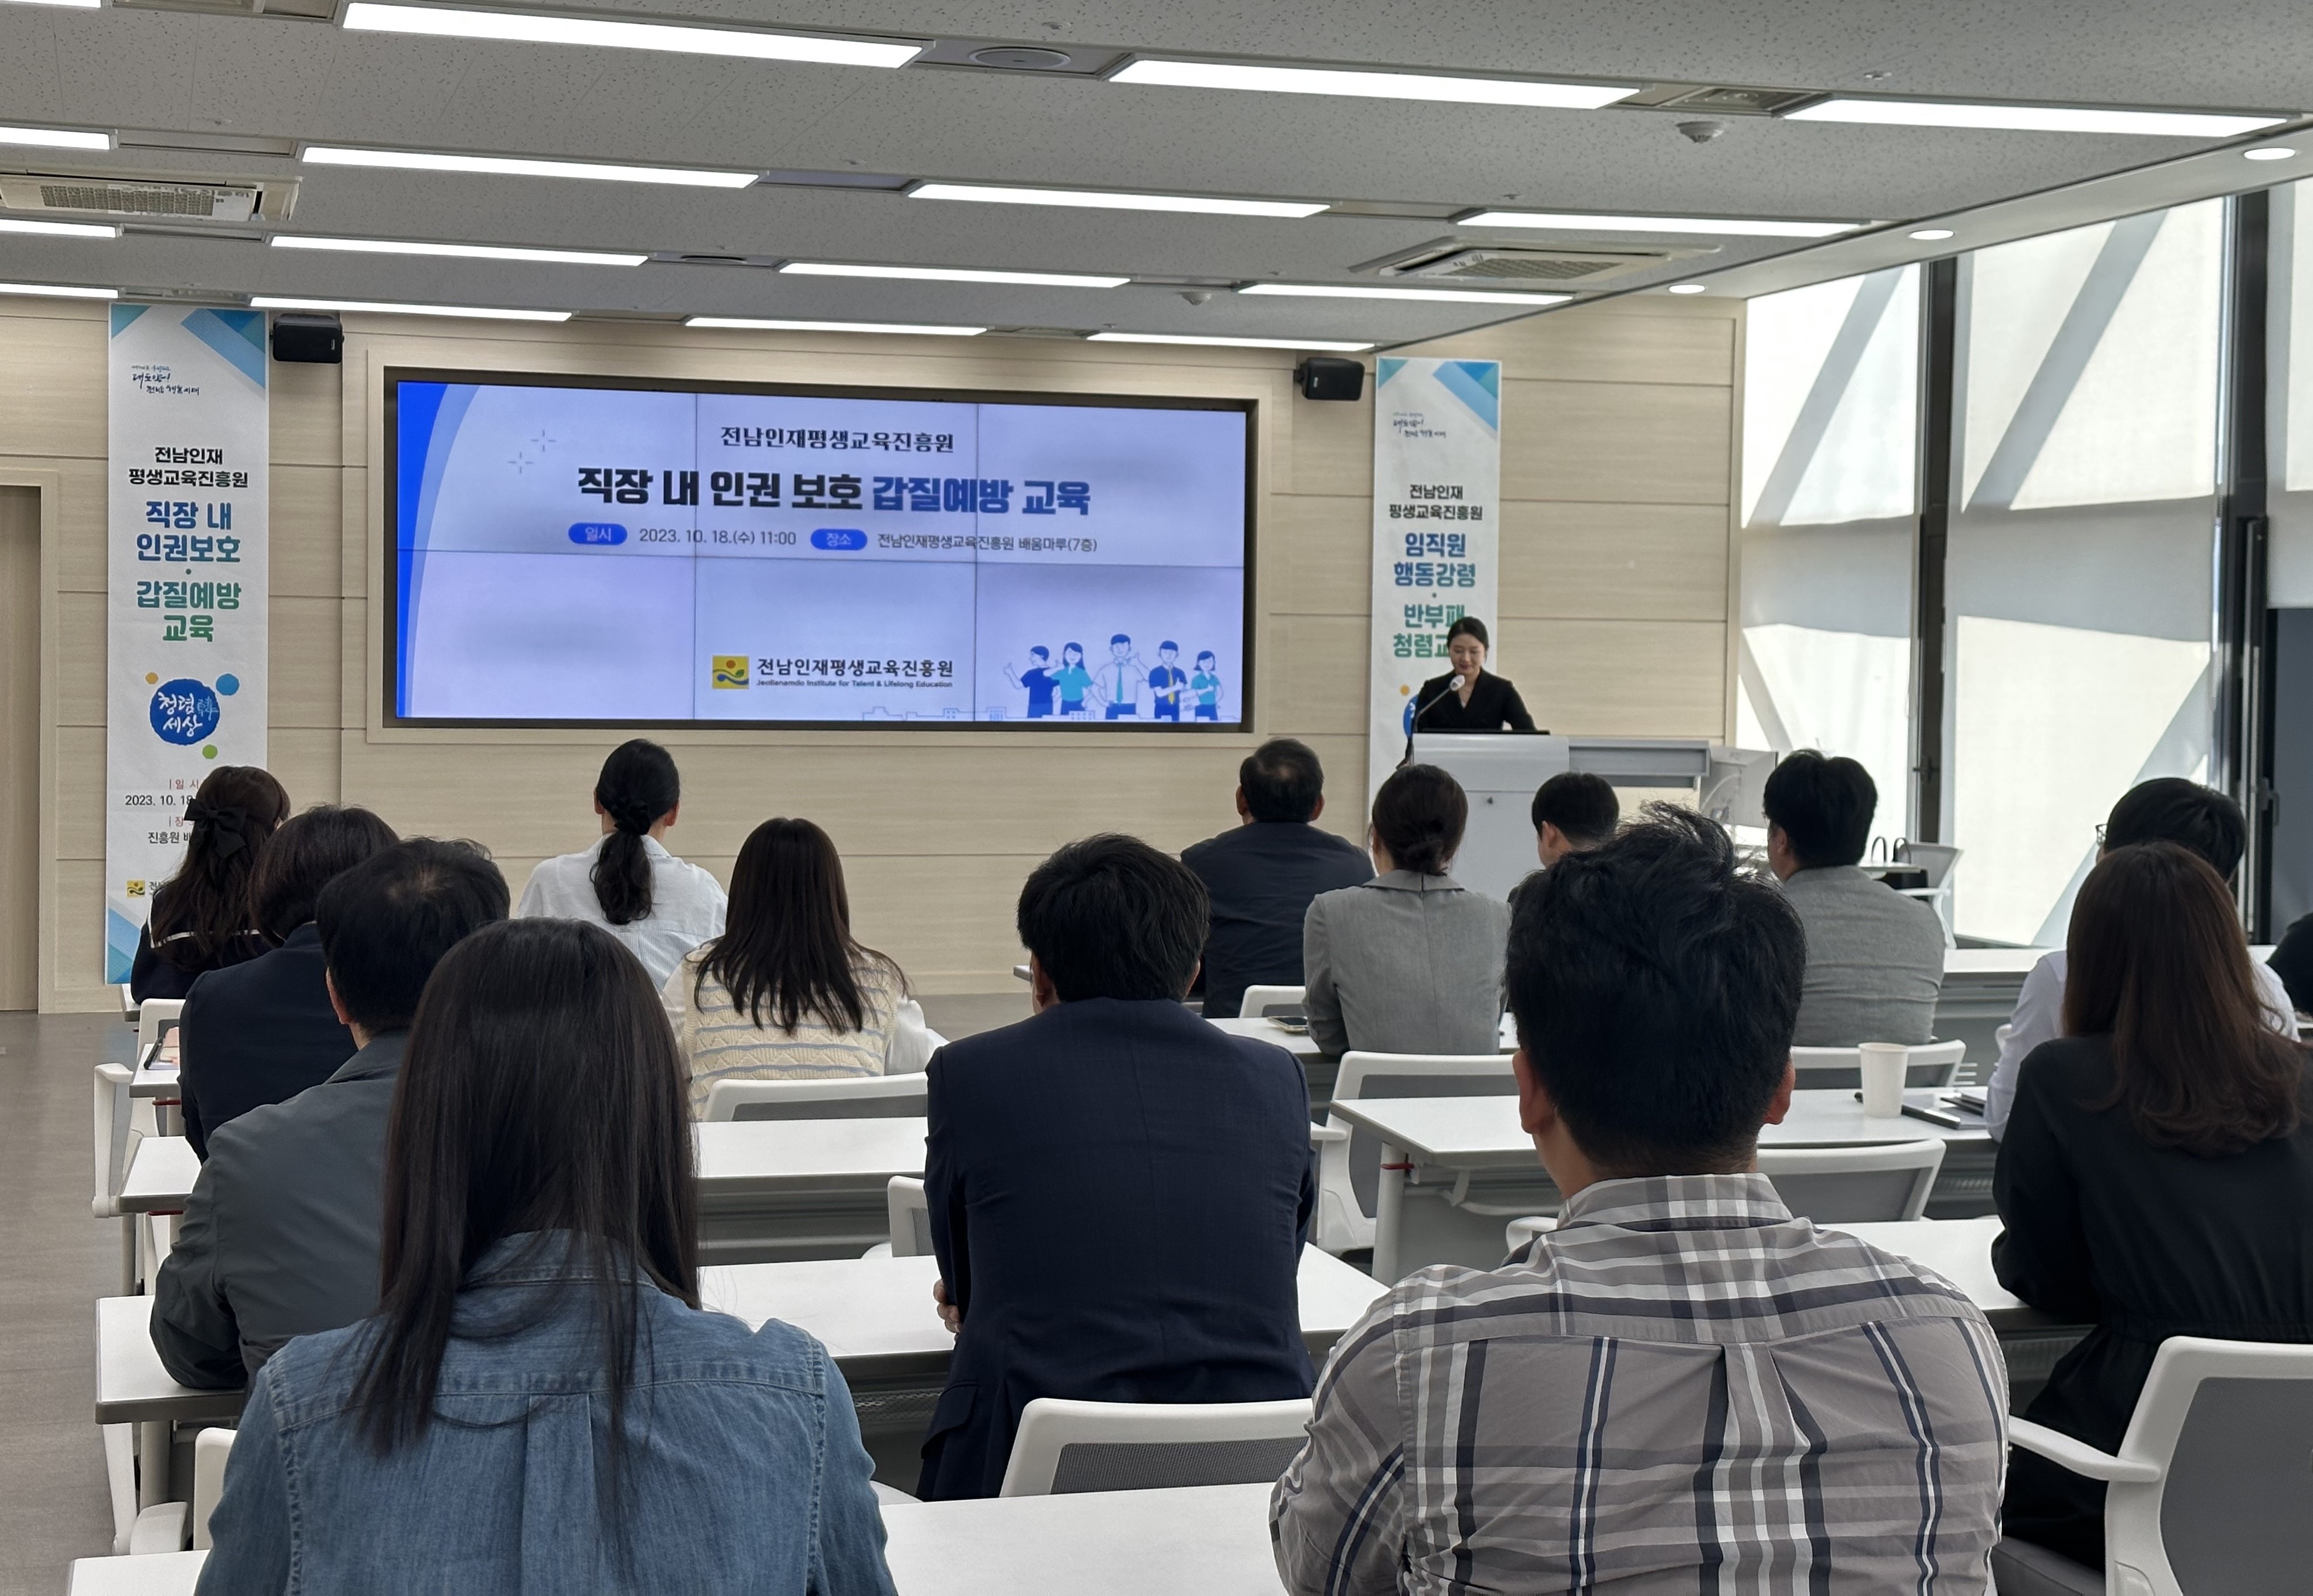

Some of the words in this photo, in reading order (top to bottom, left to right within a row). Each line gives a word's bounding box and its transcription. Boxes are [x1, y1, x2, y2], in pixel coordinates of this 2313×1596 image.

[721, 426, 954, 453] 전남인재평생교육진흥원
[155, 447, 223, 465] 전남인재
[129, 469, 248, 488] 평생교육진흥원
[578, 467, 653, 504] 직장
[663, 470, 699, 506] 내
[710, 471, 781, 508] 인권
[791, 473, 863, 510] 보호
[873, 476, 1013, 514] 갑질예방
[1022, 480, 1091, 516] 교육
[1410, 484, 1463, 500] 전남인재
[146, 501, 199, 529] 직장
[207, 502, 232, 530] 내
[1389, 504, 1483, 521] 평생교육진흥원
[136, 534, 241, 563] 인권보호
[585, 527, 611, 542] 일시
[639, 528, 681, 543] 2023.
[686, 529, 707, 544] 10.
[761, 531, 797, 546] 11:00
[826, 532, 852, 547] 장소
[878, 533, 1014, 551] 전남인재평생교육진흥원
[1019, 537, 1098, 553] 배움마루(7층)
[1405, 533, 1466, 558] 임직원
[1394, 561, 1476, 587] 행동강령
[136, 581, 242, 610] 갑질예방
[162, 614, 214, 642] 교육
[1404, 603, 1465, 628] 반부패
[1393, 633, 1449, 658] 청렴교
[757, 658, 953, 677] 전남인재평생교육진흥원
[884, 680, 914, 689] Lifelong
[163, 714, 203, 737] 세상
[125, 795, 156, 806] 2023.
[160, 795, 176, 806] 10.
[148, 831, 179, 844] 진흥원
